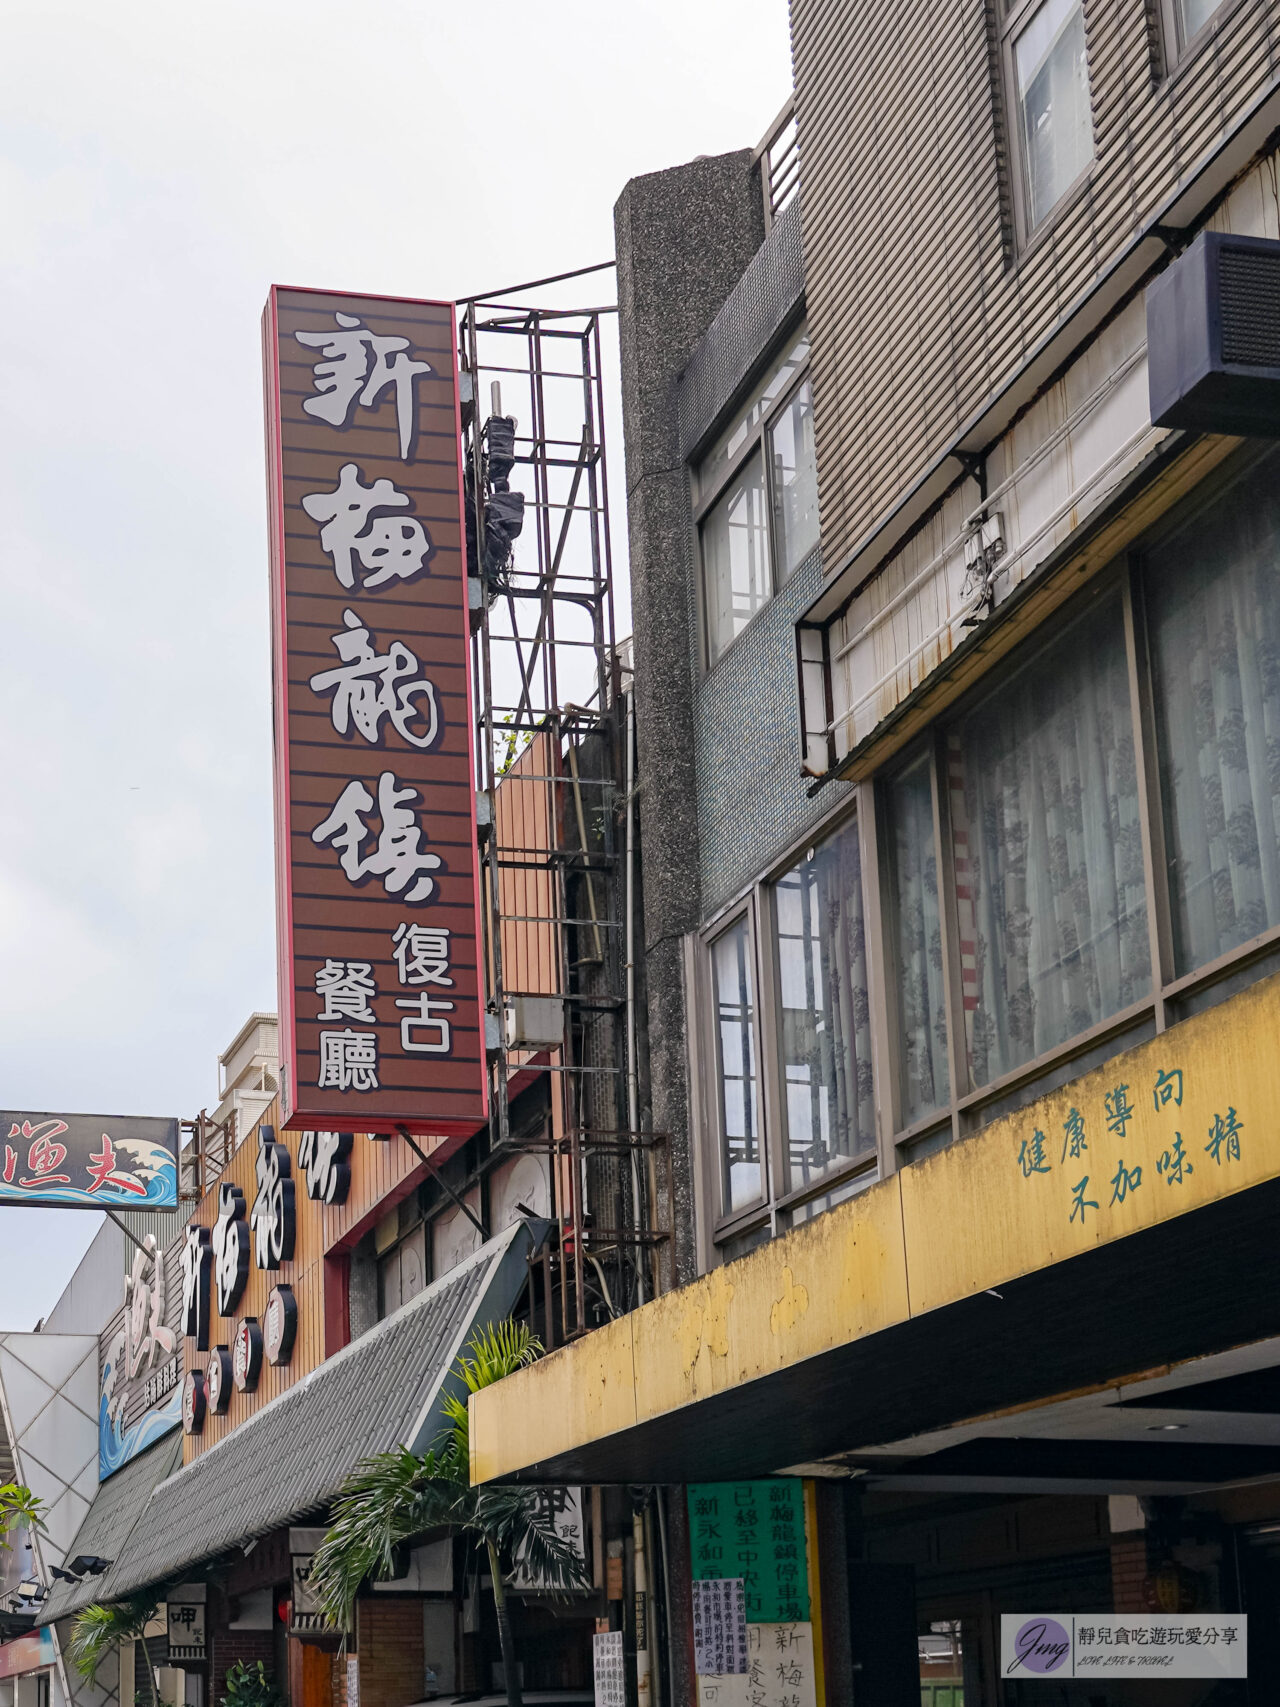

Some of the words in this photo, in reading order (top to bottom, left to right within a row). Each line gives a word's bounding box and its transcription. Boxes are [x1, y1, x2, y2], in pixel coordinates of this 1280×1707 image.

[294, 311, 442, 902] 新梅龍鎮
[315, 958, 379, 1091] 餐廳
[392, 922, 454, 1054] 復古
[1018, 1069, 1184, 1178] 健康導向
[1070, 1106, 1245, 1225] 不加味精
